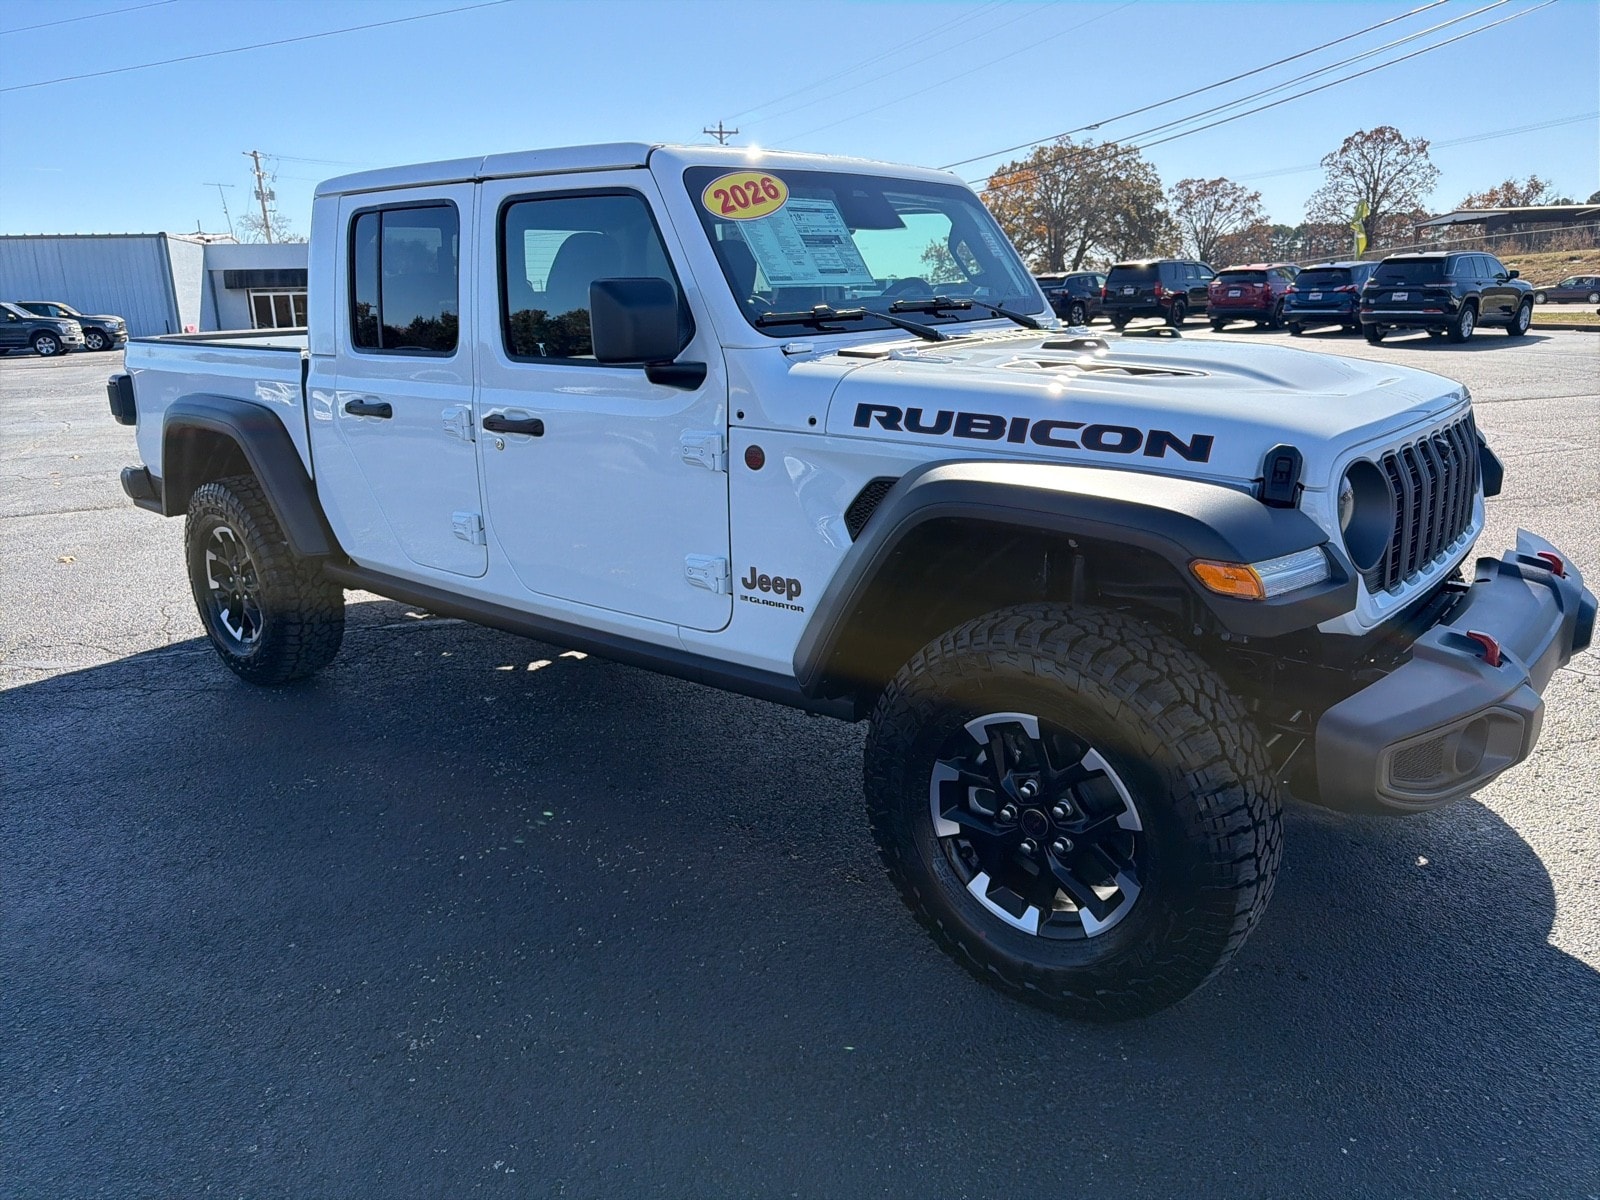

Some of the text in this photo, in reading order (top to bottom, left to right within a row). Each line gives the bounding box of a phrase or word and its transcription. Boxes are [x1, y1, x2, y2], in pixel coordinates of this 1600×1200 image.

[713, 177, 780, 214] 2026
[853, 402, 1214, 463] RUBICON
[741, 566, 802, 601] Jeep
[749, 596, 805, 613] GLADIATOR
